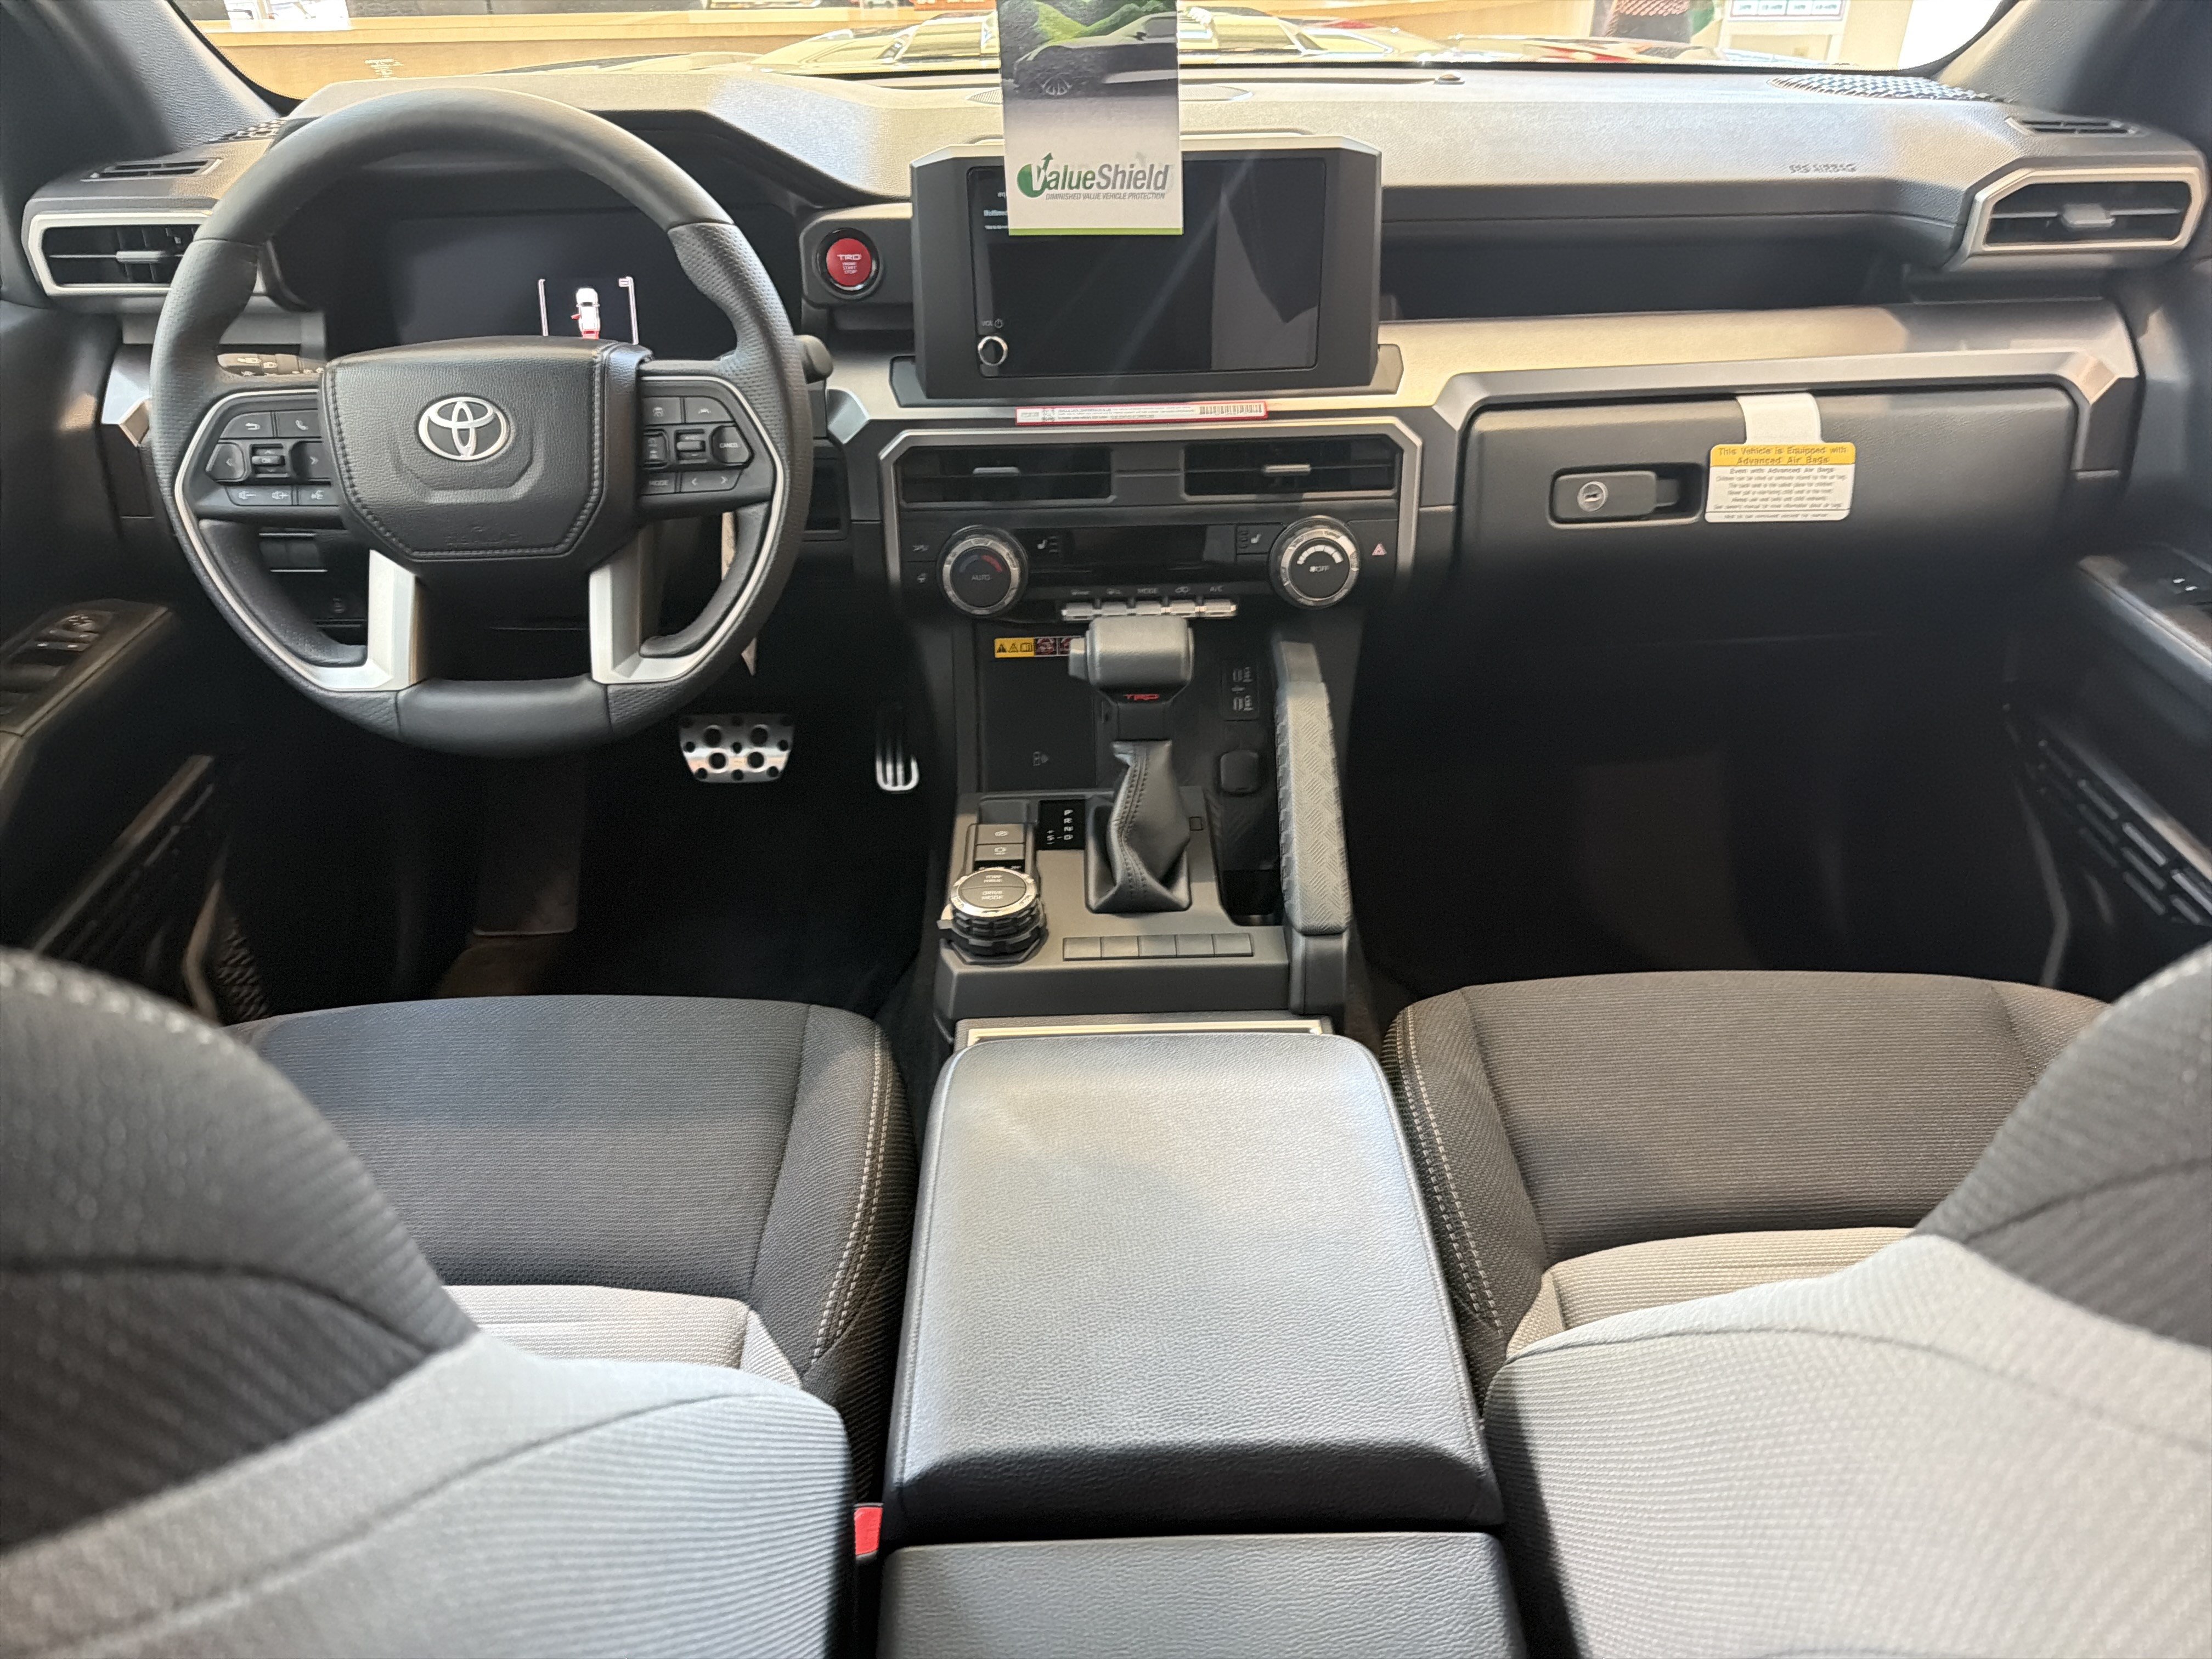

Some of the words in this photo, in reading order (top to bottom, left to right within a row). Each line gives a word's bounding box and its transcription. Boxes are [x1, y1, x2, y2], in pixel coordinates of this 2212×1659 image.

[1018, 157, 1169, 194] ValueShield
[1719, 447, 1737, 455] This
[1741, 447, 1770, 455] Vehicle
[1787, 446, 1826, 456] Equipped
[1830, 446, 1847, 454] with
[1737, 456, 1782, 465] Advanced
[1787, 456, 1801, 465] Air
[1806, 456, 1830, 465] Bags
